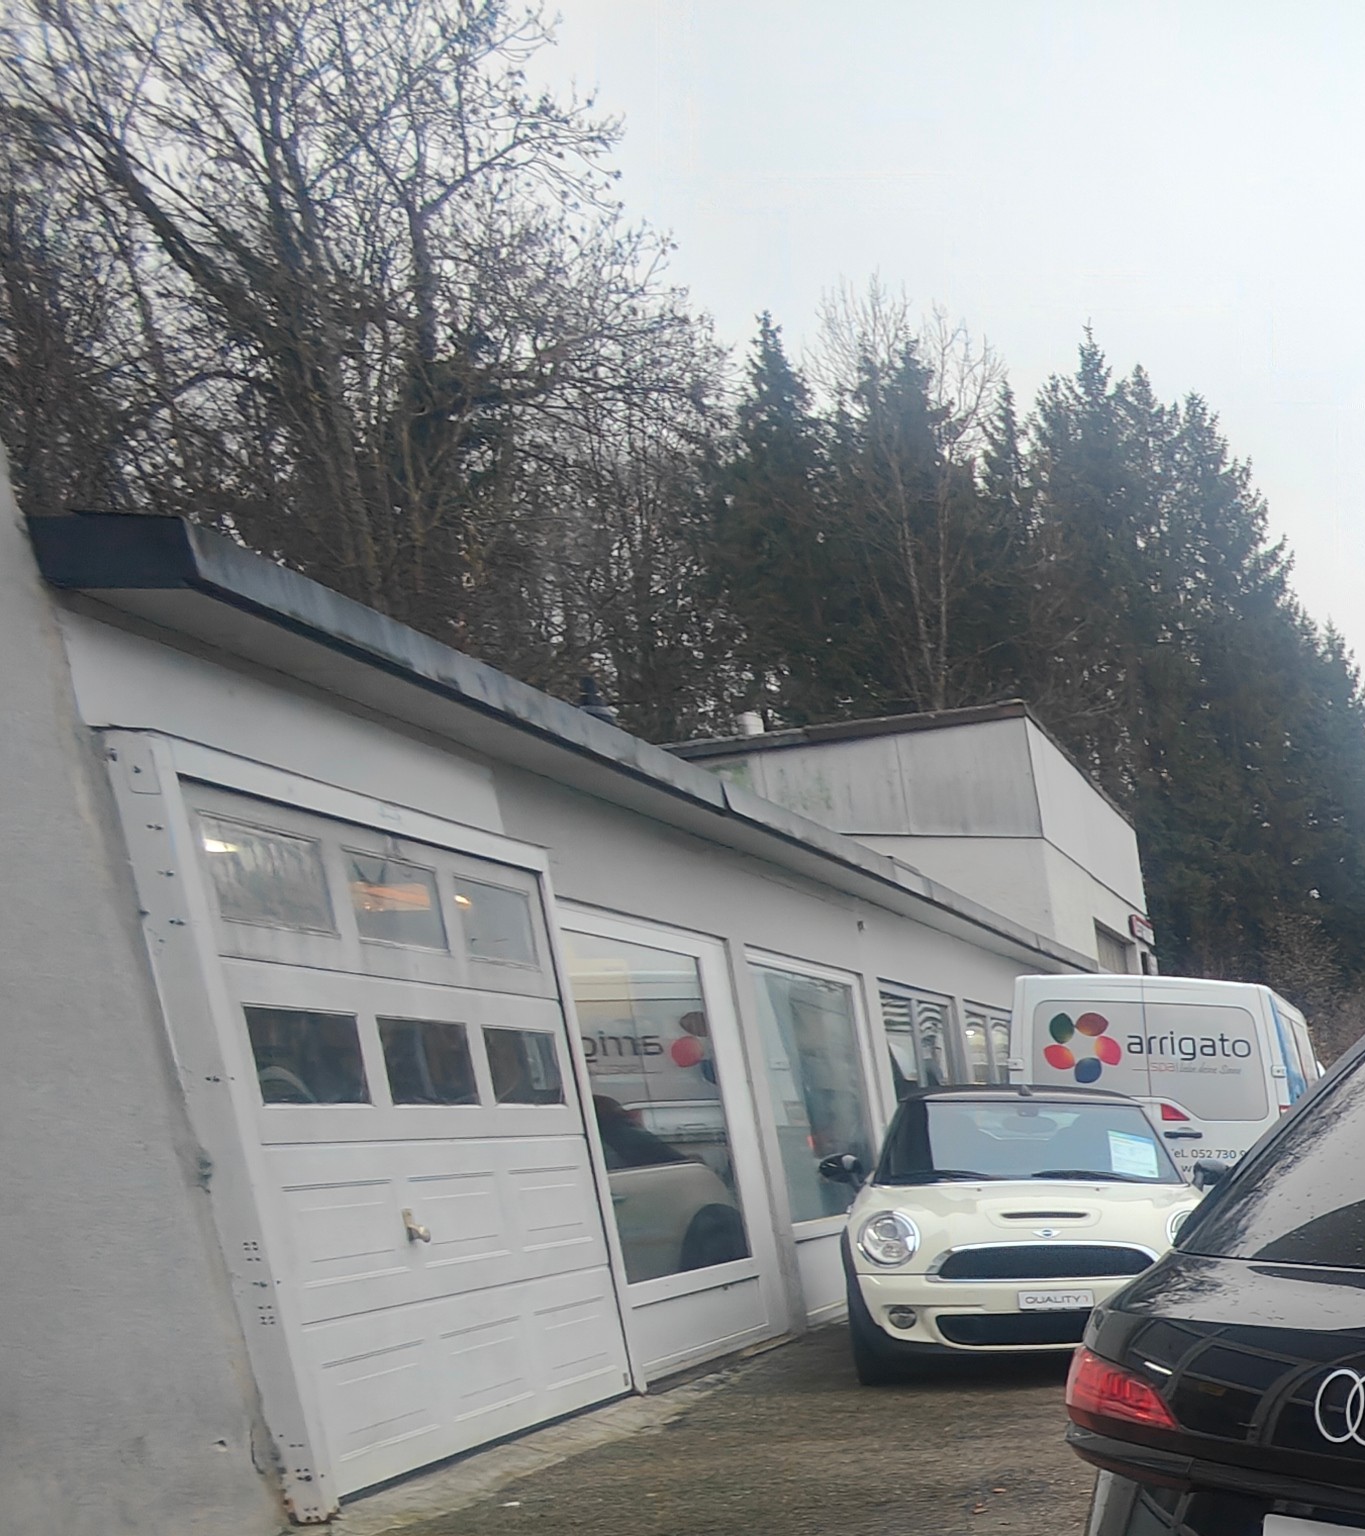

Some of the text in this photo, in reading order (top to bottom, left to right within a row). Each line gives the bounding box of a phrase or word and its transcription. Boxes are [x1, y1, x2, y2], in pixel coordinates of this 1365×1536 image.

[1126, 1031, 1251, 1061] arrigato
[1191, 1149, 1212, 1158] 052
[1216, 1150, 1237, 1159] 730
[1025, 1295, 1081, 1304] QUALITY
